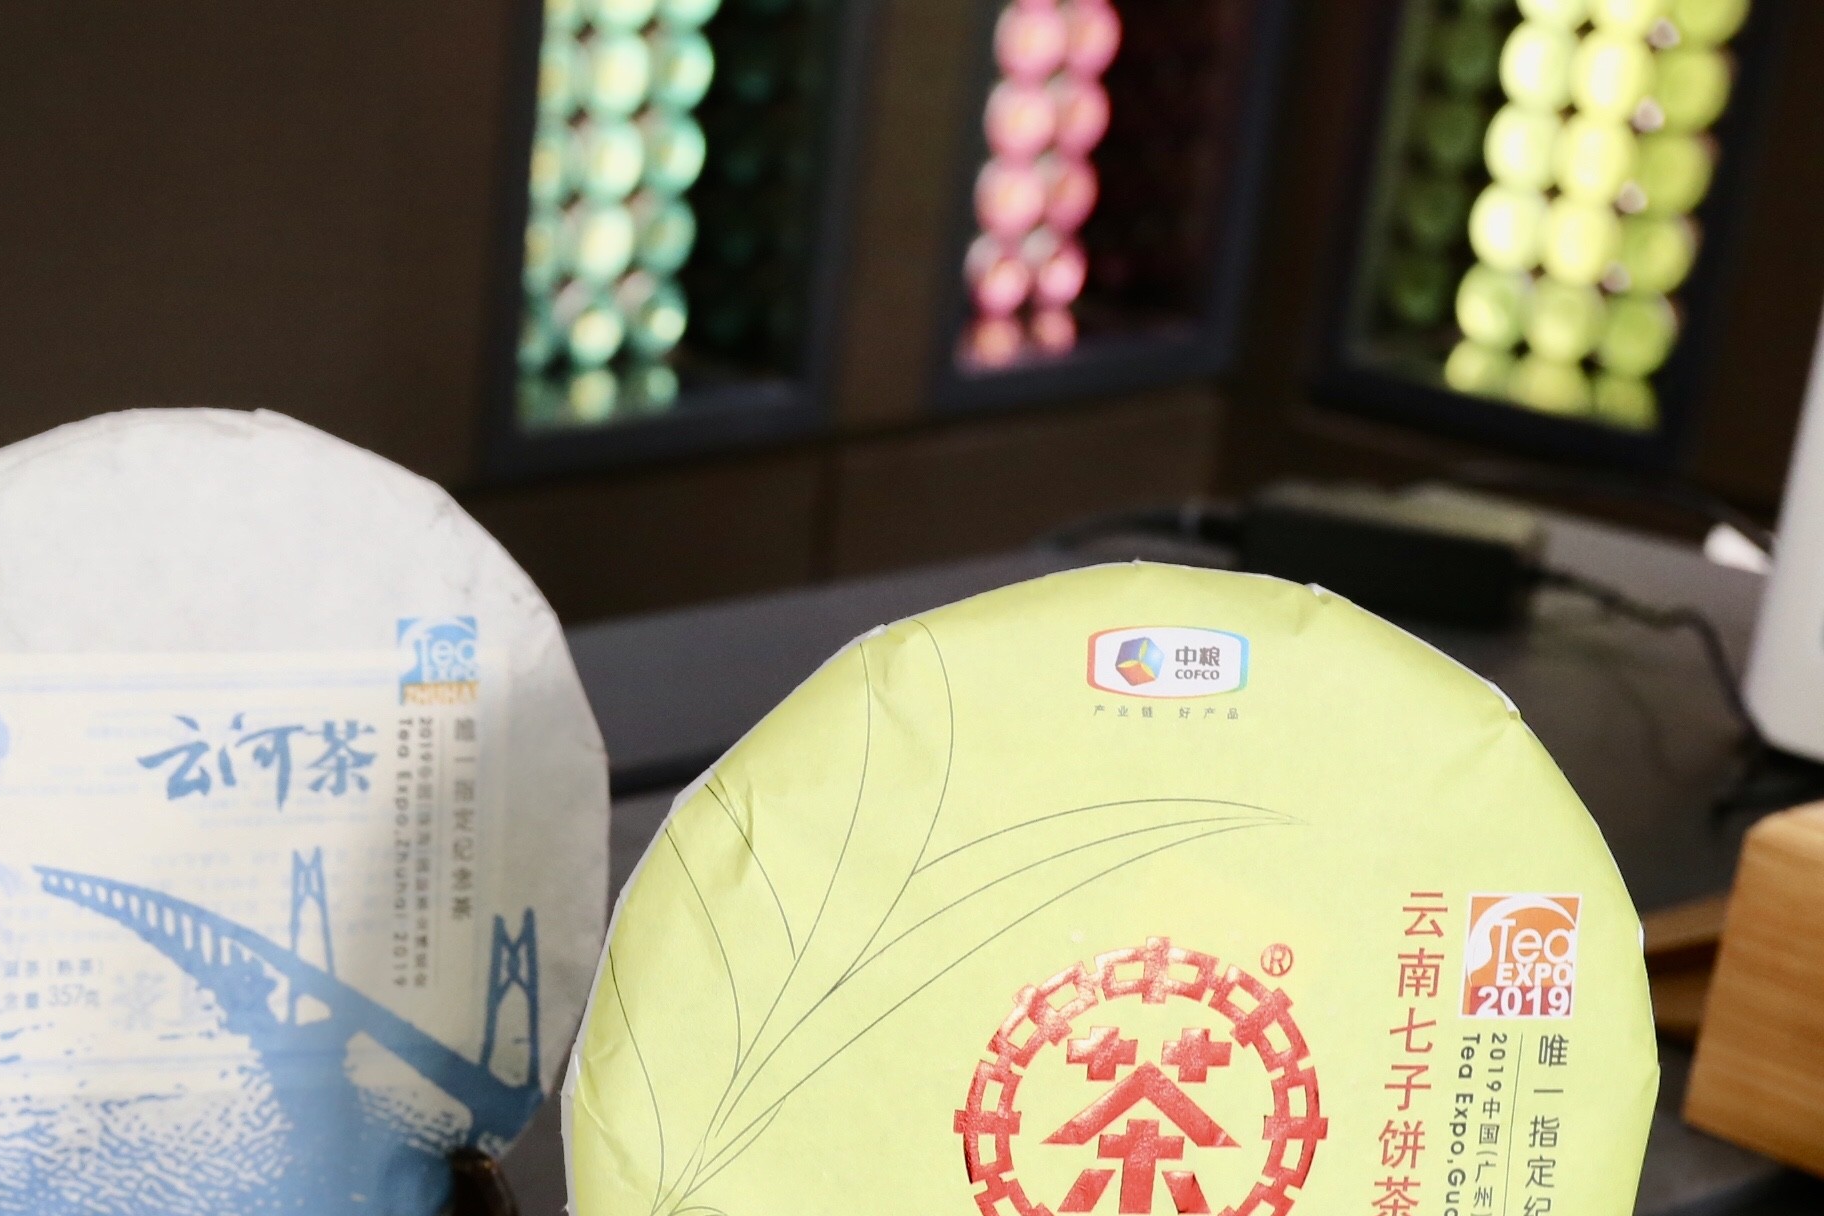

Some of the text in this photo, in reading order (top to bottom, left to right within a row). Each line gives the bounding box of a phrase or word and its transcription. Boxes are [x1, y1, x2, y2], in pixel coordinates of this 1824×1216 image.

[1175, 646, 1220, 667] 中粮
[1175, 669, 1220, 680] COFCO
[136, 712, 377, 812] 云河茶
[1492, 918, 1576, 963] Tea
[1495, 962, 1574, 987] EXPO
[1476, 986, 1571, 1016] 2019
[1458, 1033, 1481, 1079] Tea
